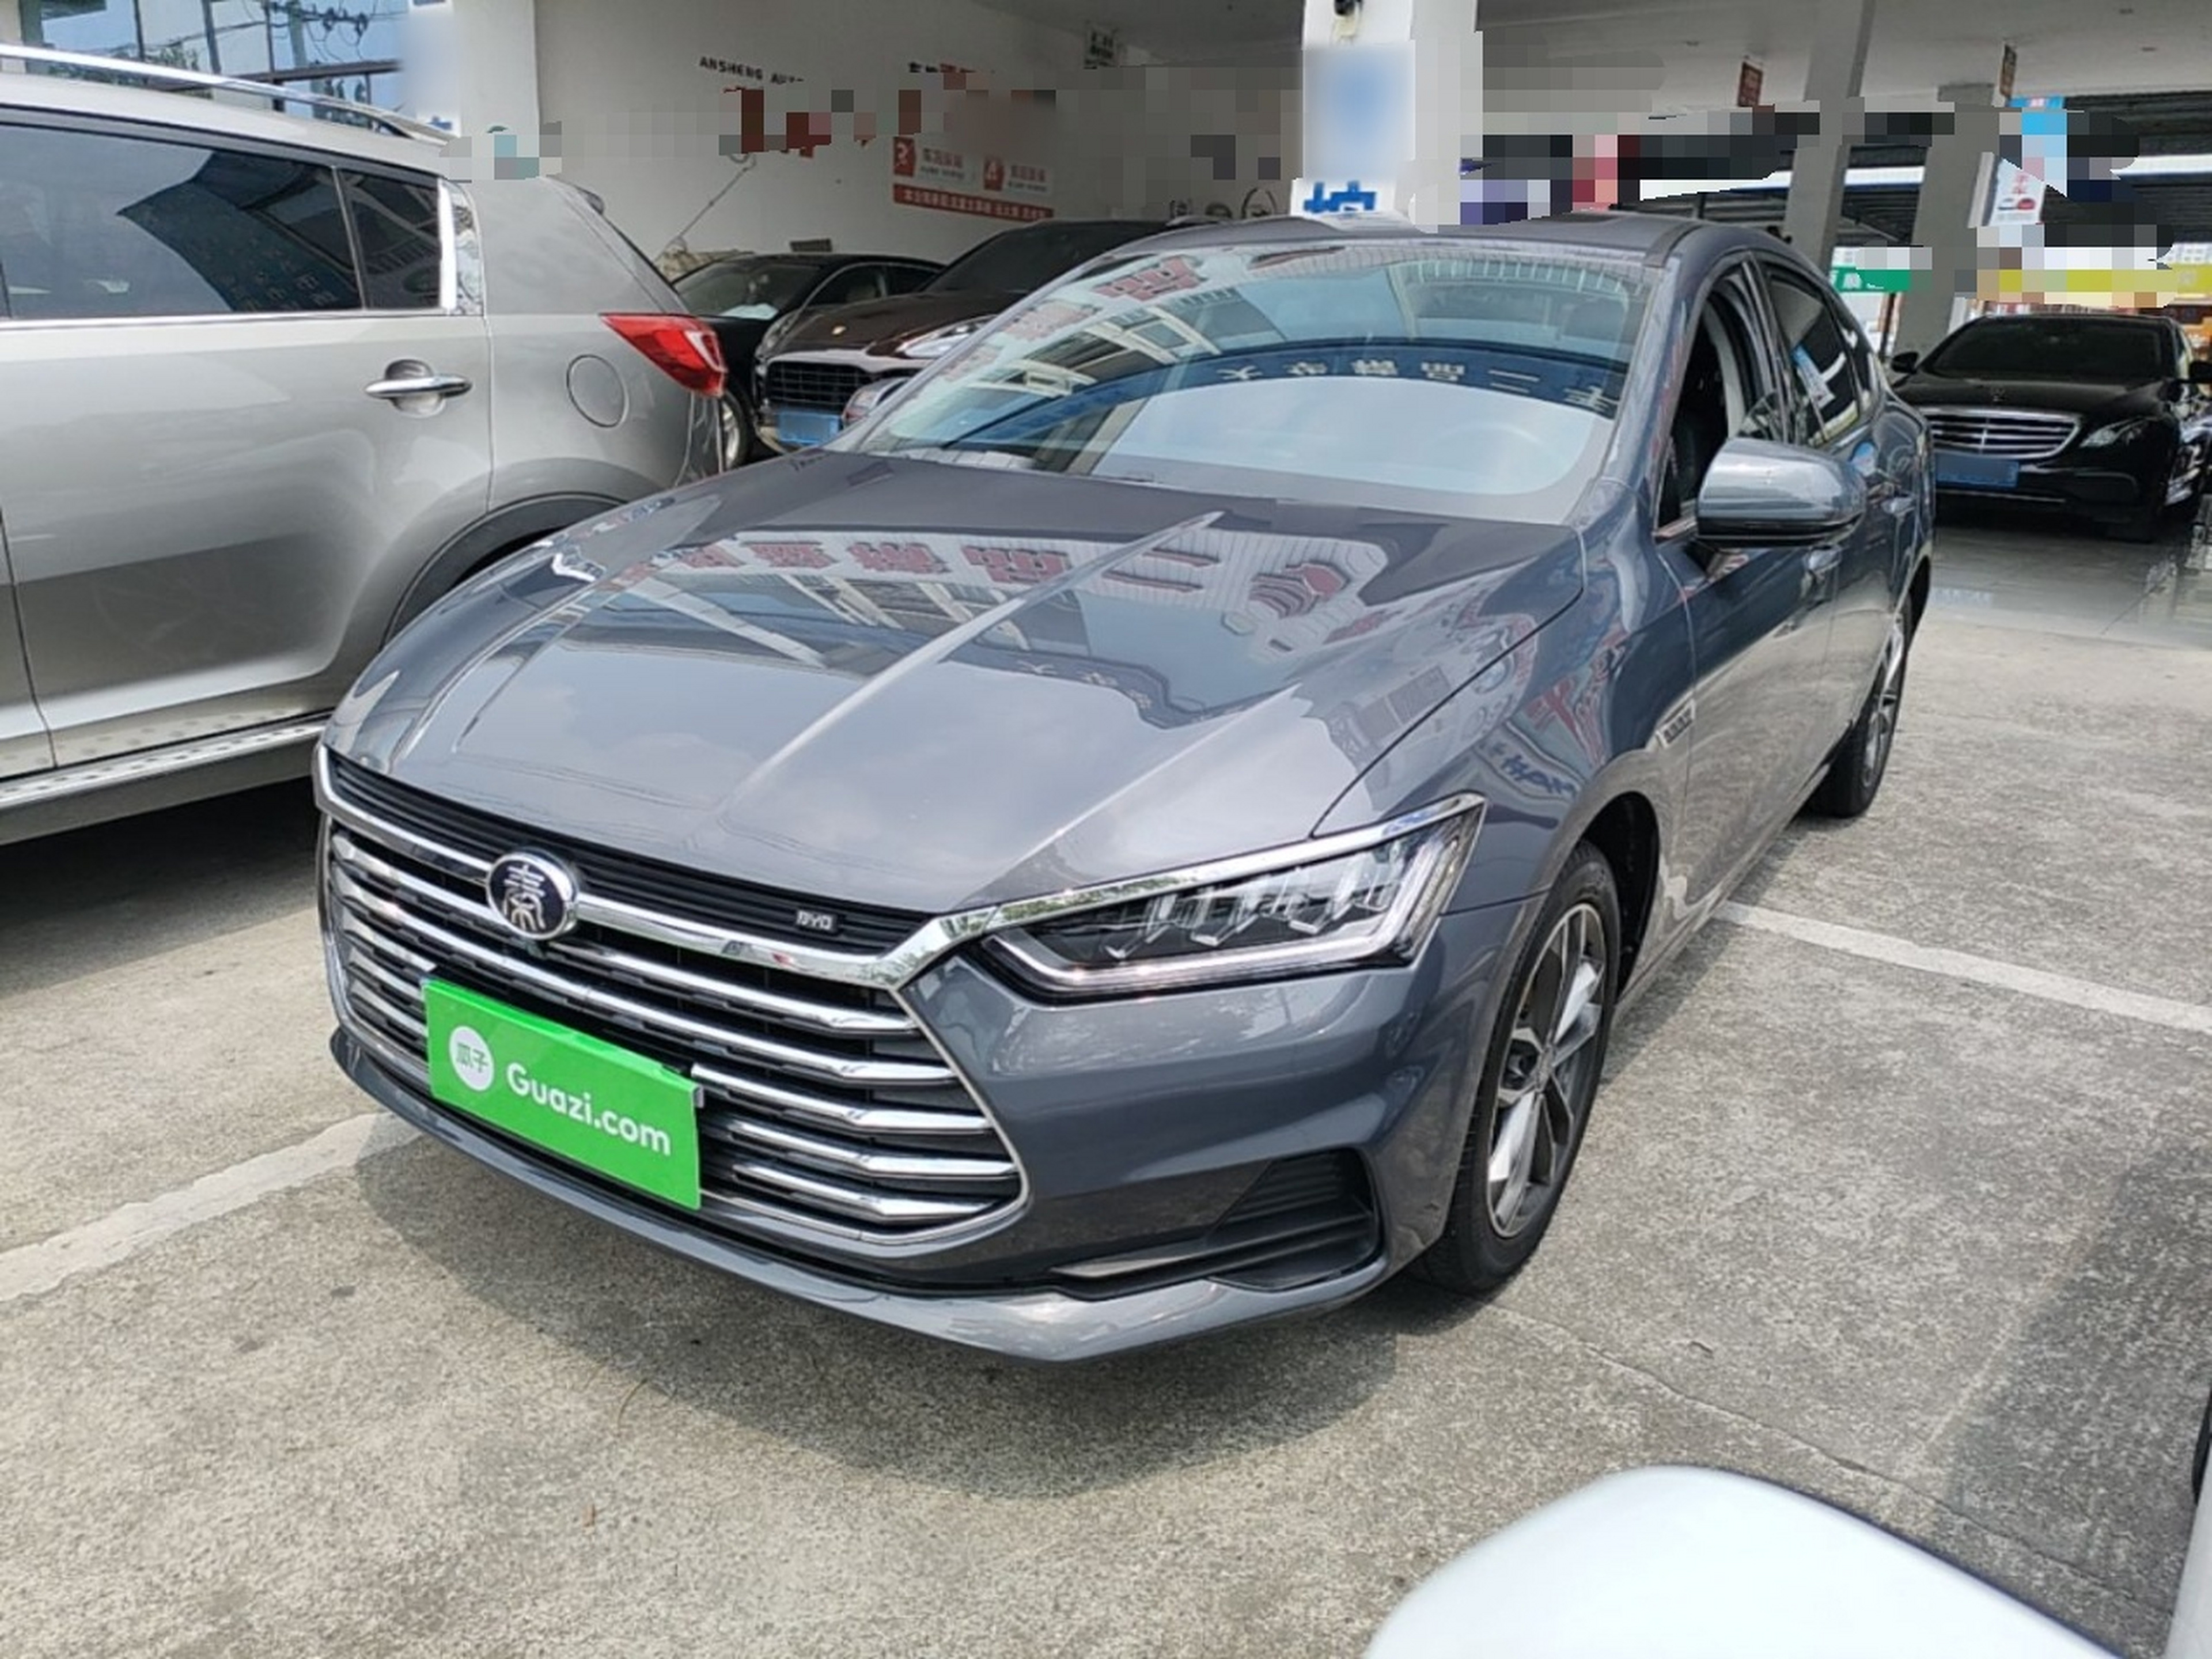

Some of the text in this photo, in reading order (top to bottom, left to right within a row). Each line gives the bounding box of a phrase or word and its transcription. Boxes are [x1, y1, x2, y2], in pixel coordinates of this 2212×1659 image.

[699, 56, 805, 85] ANSHENG AU
[457, 1041, 488, 1074] 瓜子
[505, 1061, 672, 1157] Guazi.com
